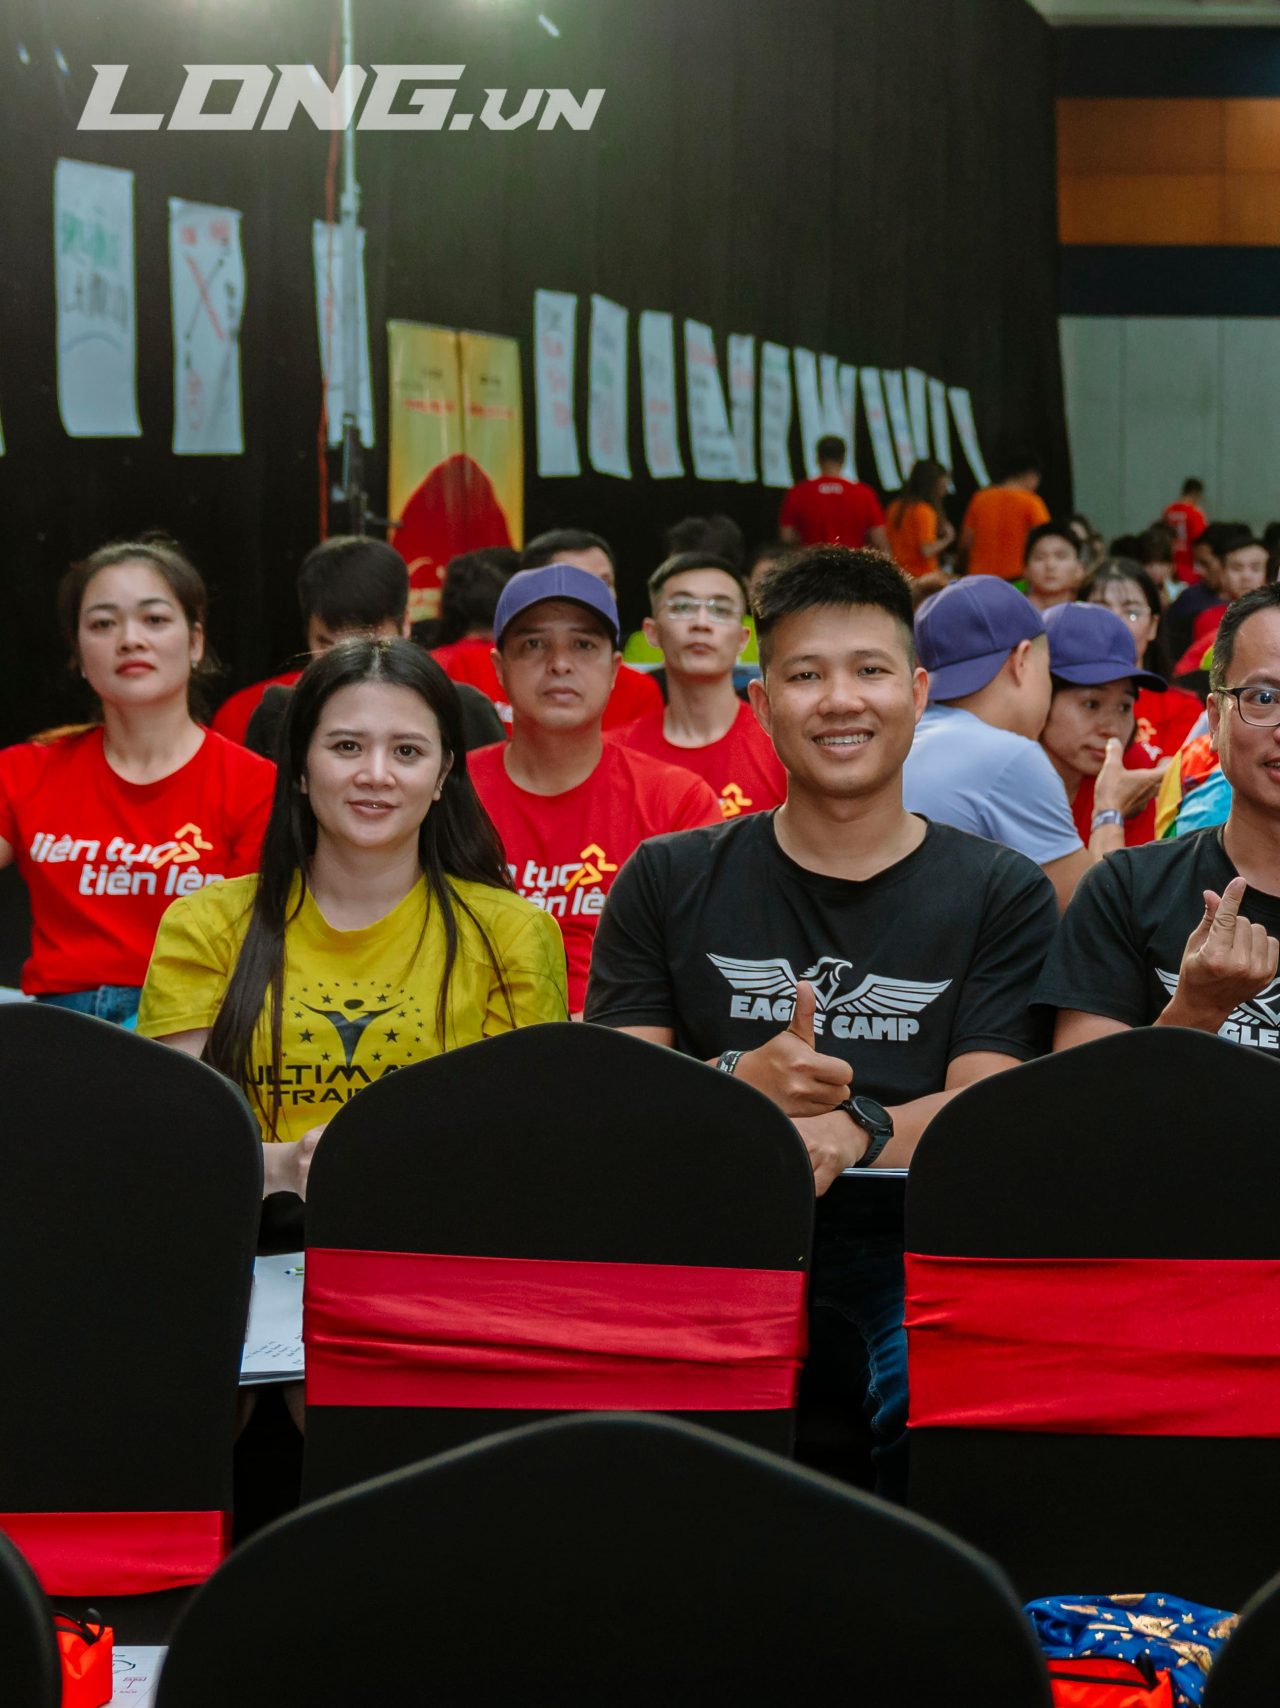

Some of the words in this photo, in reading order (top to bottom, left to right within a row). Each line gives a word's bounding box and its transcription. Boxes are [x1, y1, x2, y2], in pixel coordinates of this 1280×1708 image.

[30, 832, 101, 863] liên
[730, 994, 827, 1036] EAGE
[831, 1014, 920, 1042] CAMP
[1217, 1021, 1280, 1049] GLE
